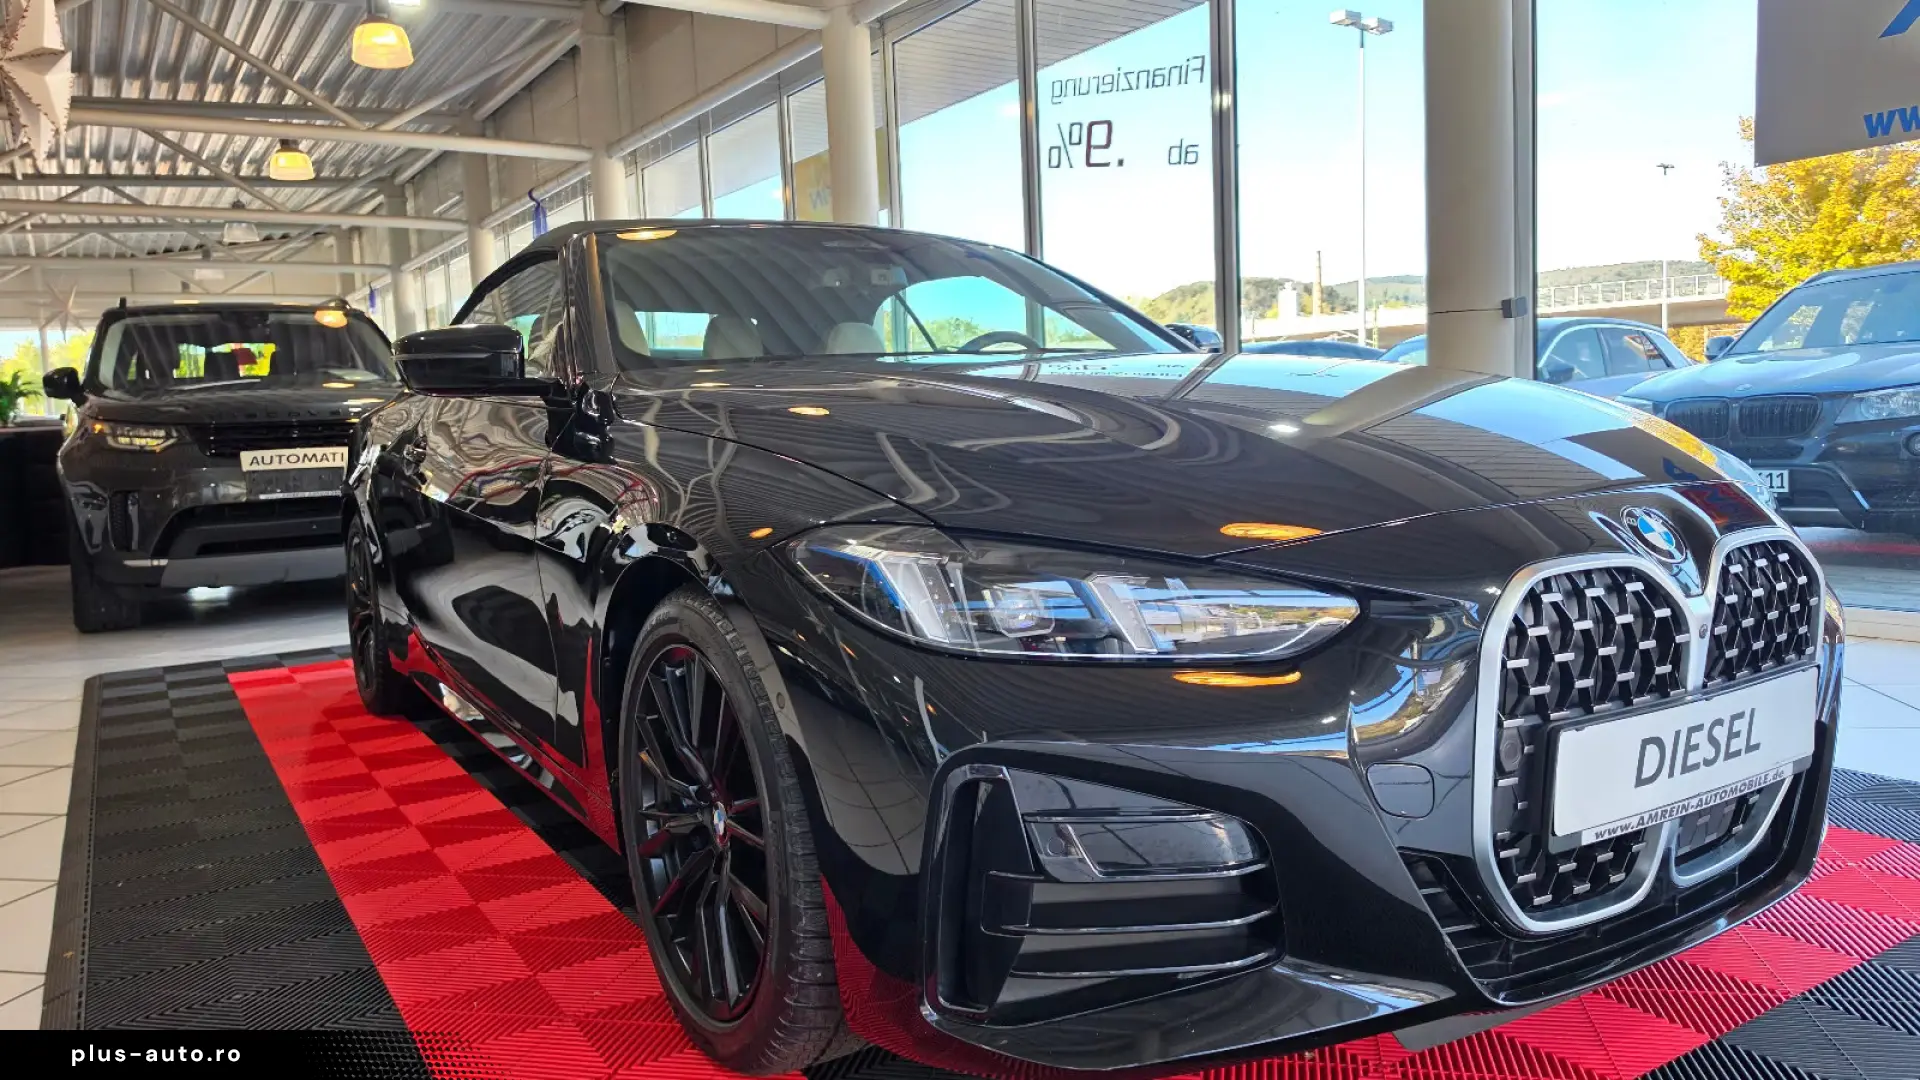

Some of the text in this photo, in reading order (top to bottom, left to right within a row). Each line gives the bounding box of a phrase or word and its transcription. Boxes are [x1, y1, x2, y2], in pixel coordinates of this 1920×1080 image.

[1758, 472, 1785, 489] 11
[1634, 707, 1762, 789] DIESEL
[1593, 768, 1785, 840] www.AMREIN-AUTOMOBILE.de
